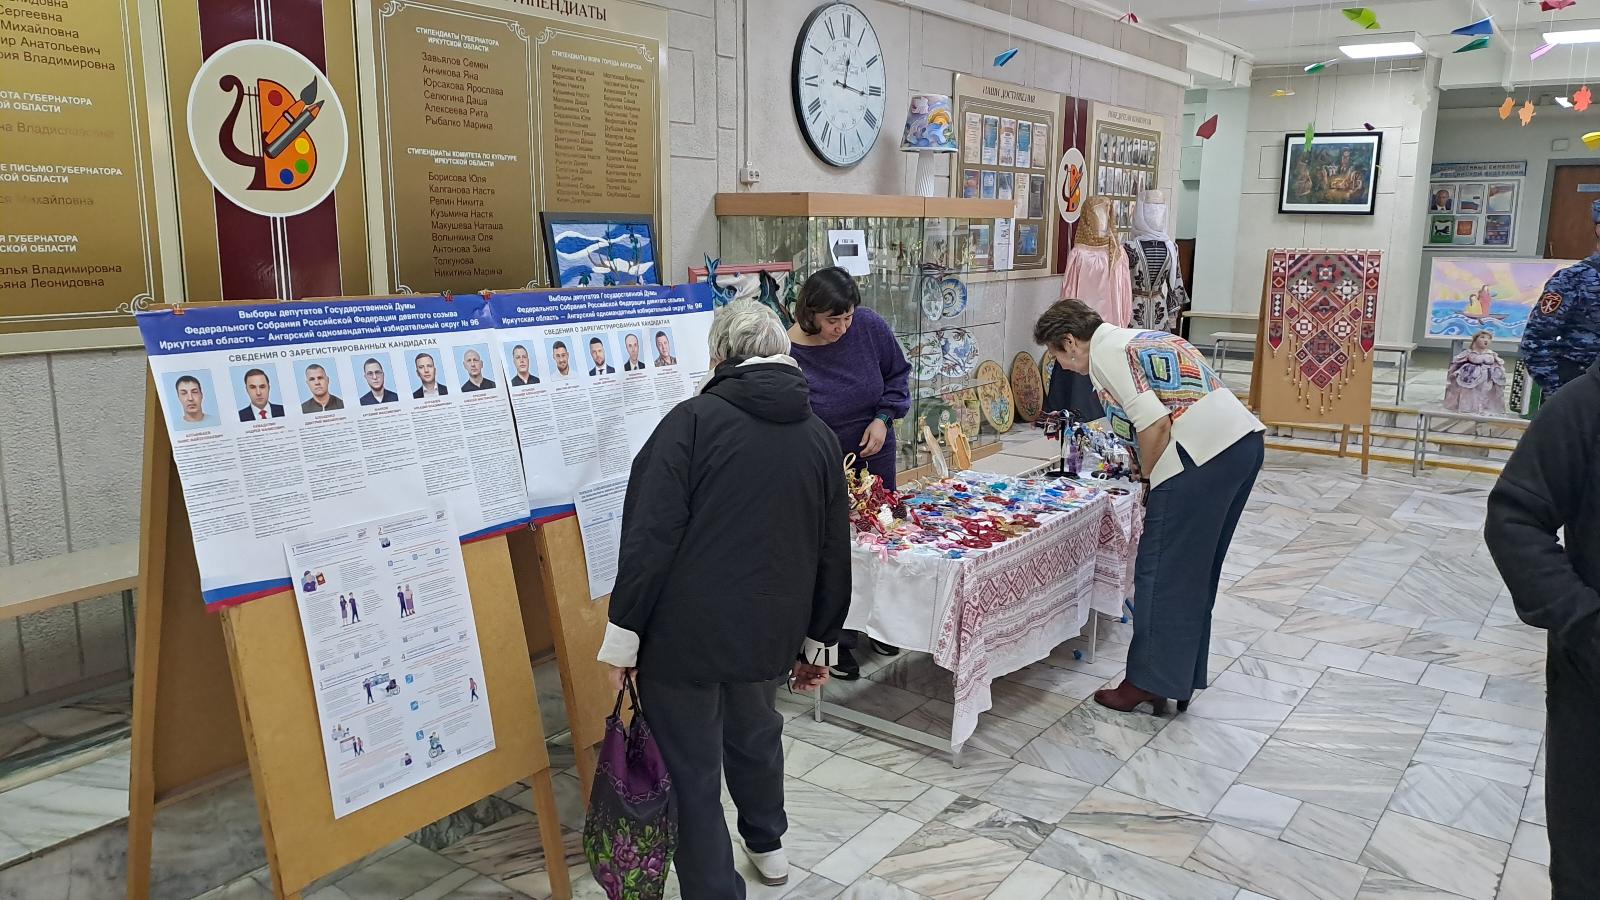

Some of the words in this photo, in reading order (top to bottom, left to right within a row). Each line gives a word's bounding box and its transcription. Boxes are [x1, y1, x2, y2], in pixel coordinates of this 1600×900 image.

[512, 0, 607, 21] ПЕНДИАТЫ
[1, 20, 79, 38] Михайловна
[415, 26, 460, 40] СТИПЕНДИАТЫ
[460, 34, 500, 47] ГУБЕРНАТОРА
[20, 37, 101, 55] Анатольевич
[463, 42, 489, 52] ОБЛАСТИ
[23, 51, 115, 70] Владимировна
[422, 51, 461, 66] Завьялов
[463, 70, 479, 80] Яна
[466, 82, 504, 96] Ярослава
[23, 92, 93, 106] ГУБЕРНАТОРА
[466, 95, 488, 106] Даша
[13, 102, 61, 113] ОБЛАСТИ
[425, 103, 468, 116] Алексеева
[469, 108, 489, 118] Рита
[463, 120, 494, 130] Марина
[407, 147, 451, 157] СТИПЕНДИАТЫ
[10, 163, 53, 173] ПИСЬМО
[55, 165, 123, 176] ГУБЕРНАТОРА
[21, 174, 69, 183] ОБЛАСТИ
[428, 172, 467, 182] Борисова
[472, 187, 495, 195] Настя
[429, 196, 454, 206] Репин
[430, 209, 469, 219] Кузьмина
[470, 210, 494, 219] Настя
[431, 221, 472, 231] Макушева
[474, 222, 503, 230] Наташа
[8, 234, 79, 243] ГУБЕРНАТОРА
[30, 244, 77, 253] ОБЛАСТИ
[32, 264, 122, 276] Владимировна
[31, 278, 105, 289] Леонидовна
[548, 294, 572, 302] Выборы
[600, 290, 644, 300] Государственной
[238, 310, 277, 320] Выборы
[279, 307, 323, 319] депутатов
[324, 303, 394, 315] Государственной
[395, 302, 416, 312] Думы
[516, 305, 559, 314] Федерального
[559, 303, 587, 311] Собрания
[587, 300, 618, 309] Российской
[184, 323, 255, 335] Федерального
[256, 318, 301, 329] Собрания
[302, 315, 353, 327] Российской
[353, 314, 397, 324] Федерации
[398, 312, 432, 322] девятого
[432, 311, 458, 319] созыва
[501, 317, 535, 326] Иркутская
[566, 311, 596, 319] Ангарский
[159, 337, 213, 350] Иркутская
[215, 334, 255, 345] область
[268, 330, 315, 341] Ангарский
[316, 325, 381, 337] одномандатный
[383, 321, 440, 332] избирательный
[440, 321, 460, 330] округ
[470, 318, 480, 326] 96
[543, 327, 574, 336] СВЕДЕНИЯ
[579, 321, 641, 334] ЗАРЕГИСТРИРОВАННЫХ
[228, 351, 279, 363] СВЕДЕНИЯ
[290, 342, 387, 358] ЗАРЕГИСТРИРОВАННЫХ
[388, 338, 438, 348] КАНДИДАТАХ
